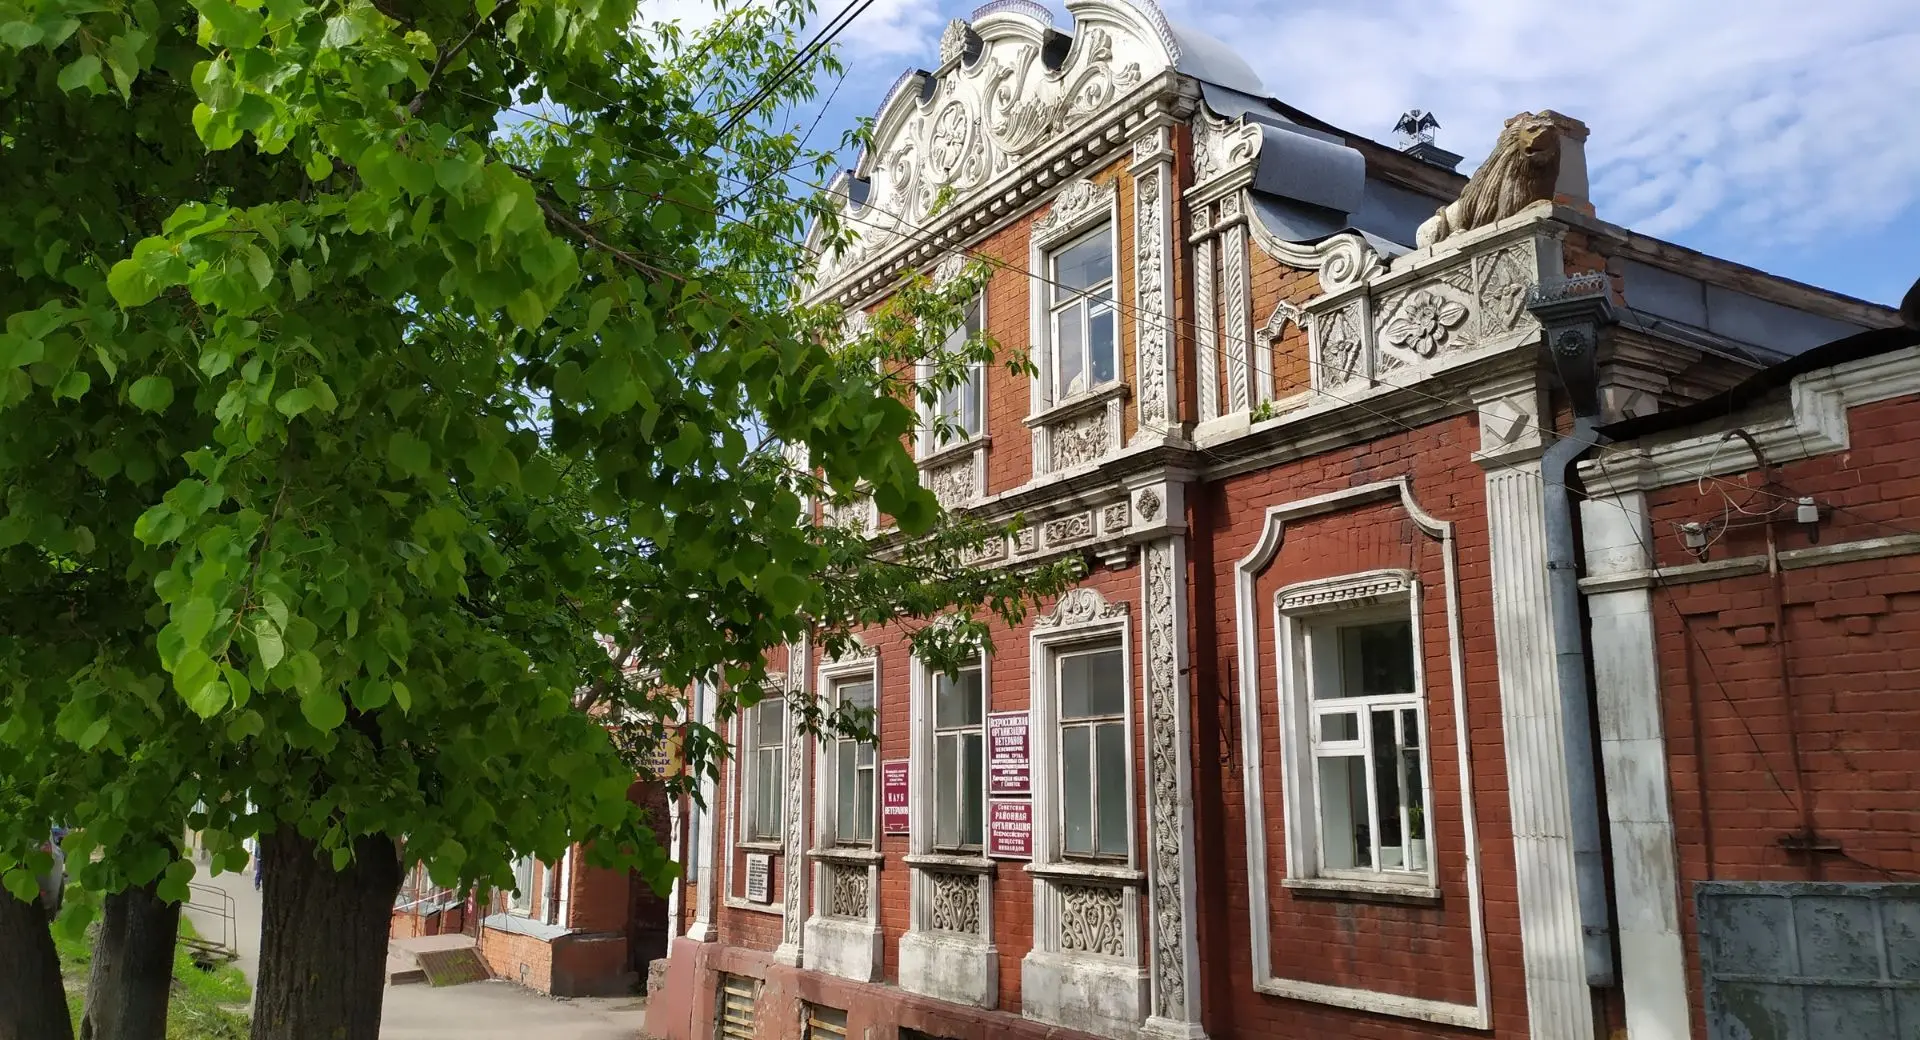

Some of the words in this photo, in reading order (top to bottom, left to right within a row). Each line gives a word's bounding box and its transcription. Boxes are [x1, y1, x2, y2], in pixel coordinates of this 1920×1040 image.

[995, 736, 1024, 746] ВЕТЕРАНОВ
[995, 811, 1027, 821] РАЙОННАЯ
[992, 821, 1031, 831] ОРГАНИЗАЦИЯ
